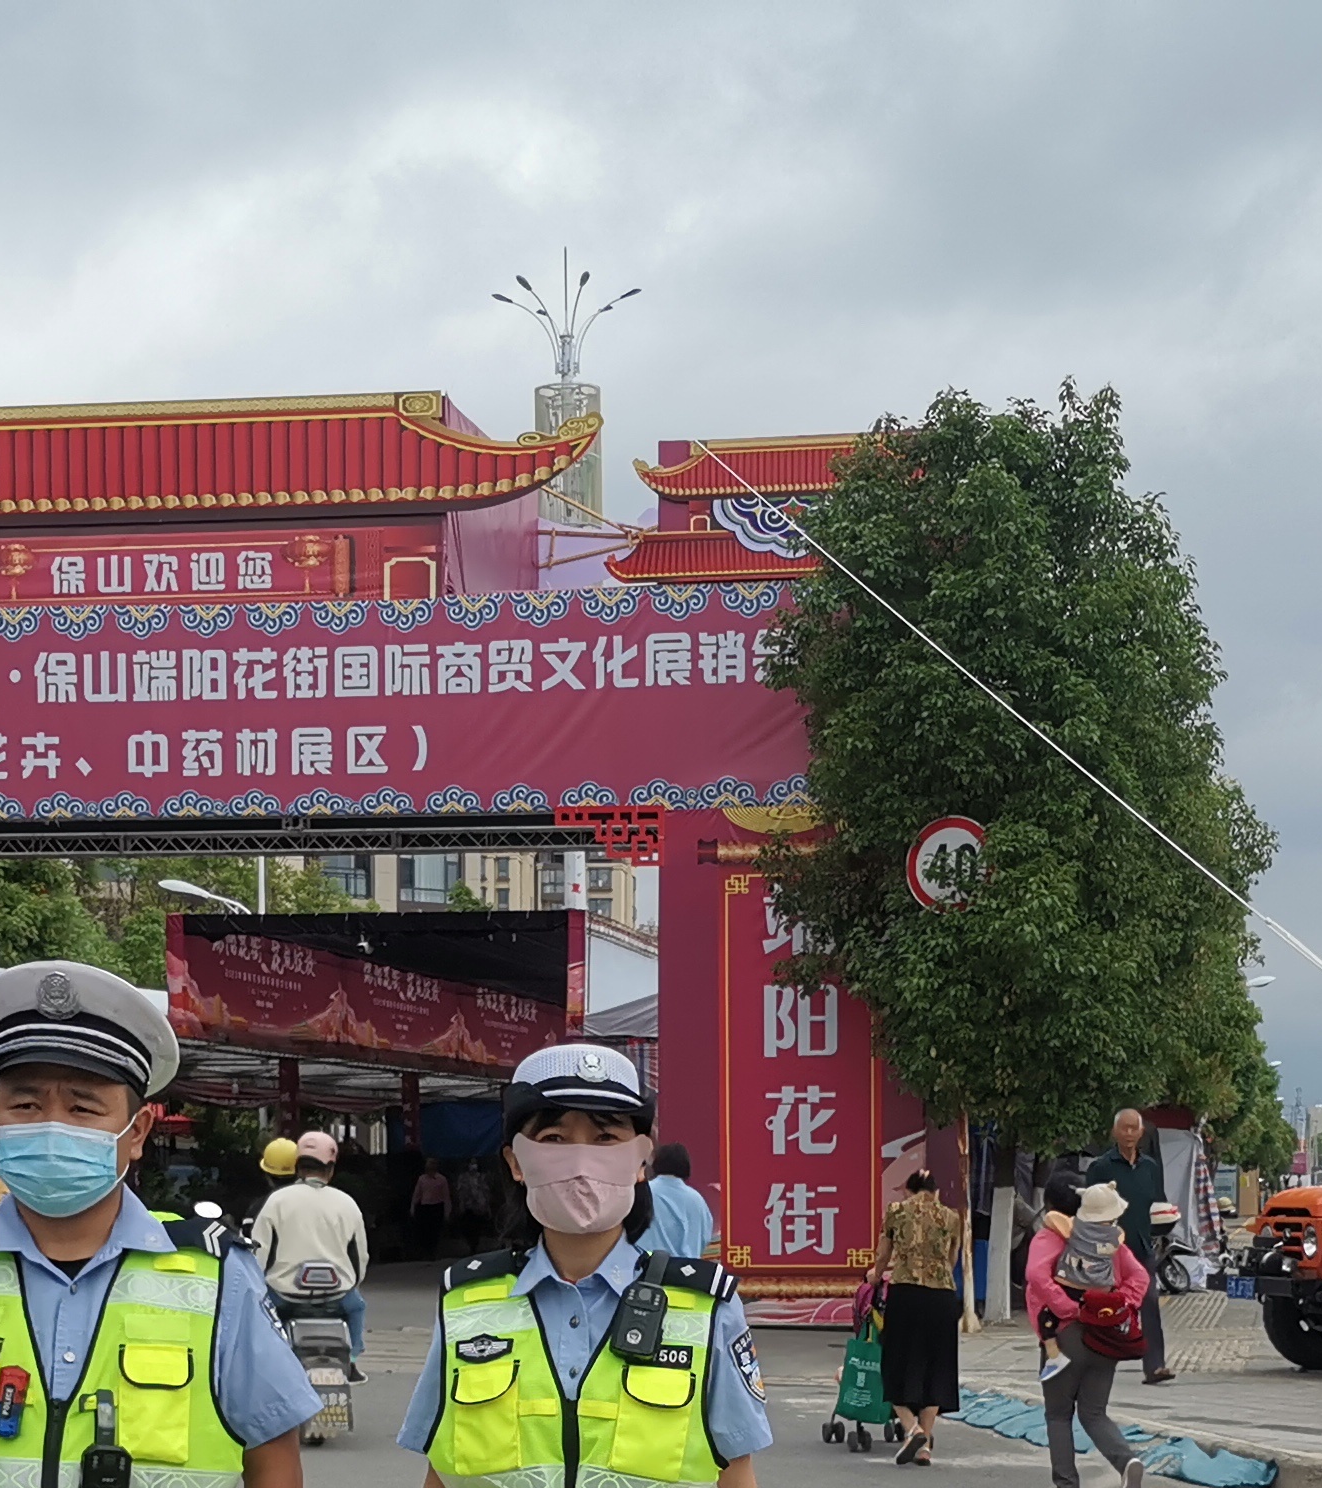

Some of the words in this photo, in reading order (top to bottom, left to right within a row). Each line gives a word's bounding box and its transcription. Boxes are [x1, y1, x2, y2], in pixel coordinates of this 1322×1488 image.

[50, 549, 274, 595] 保山欢迎您
[653, 1349, 689, 1364] 506
